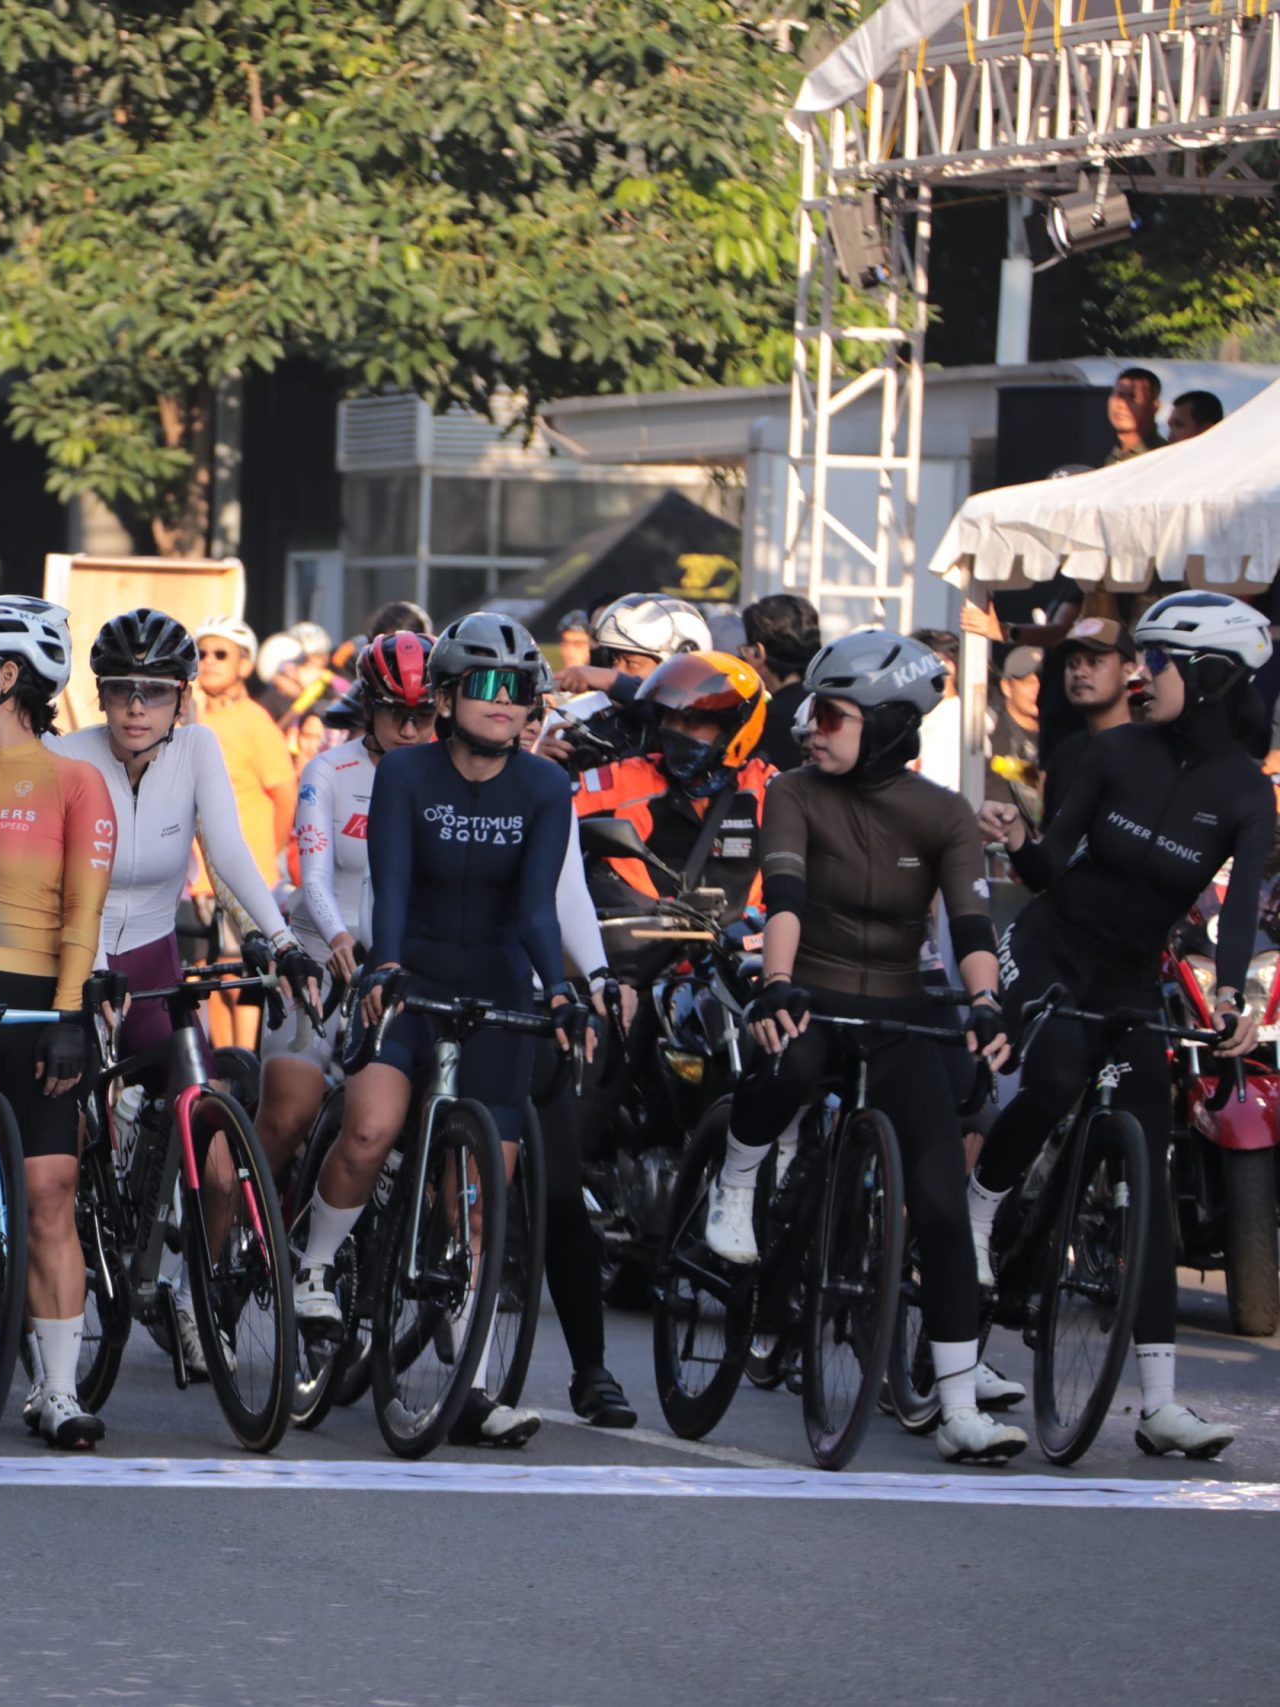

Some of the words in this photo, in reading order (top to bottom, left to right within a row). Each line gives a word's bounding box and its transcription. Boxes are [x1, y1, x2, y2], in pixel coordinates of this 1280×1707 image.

[89, 818, 114, 872] 113
[442, 813, 524, 831] OPTIMUS
[1106, 811, 1153, 840] HYPER
[1155, 835, 1203, 864] SONIC
